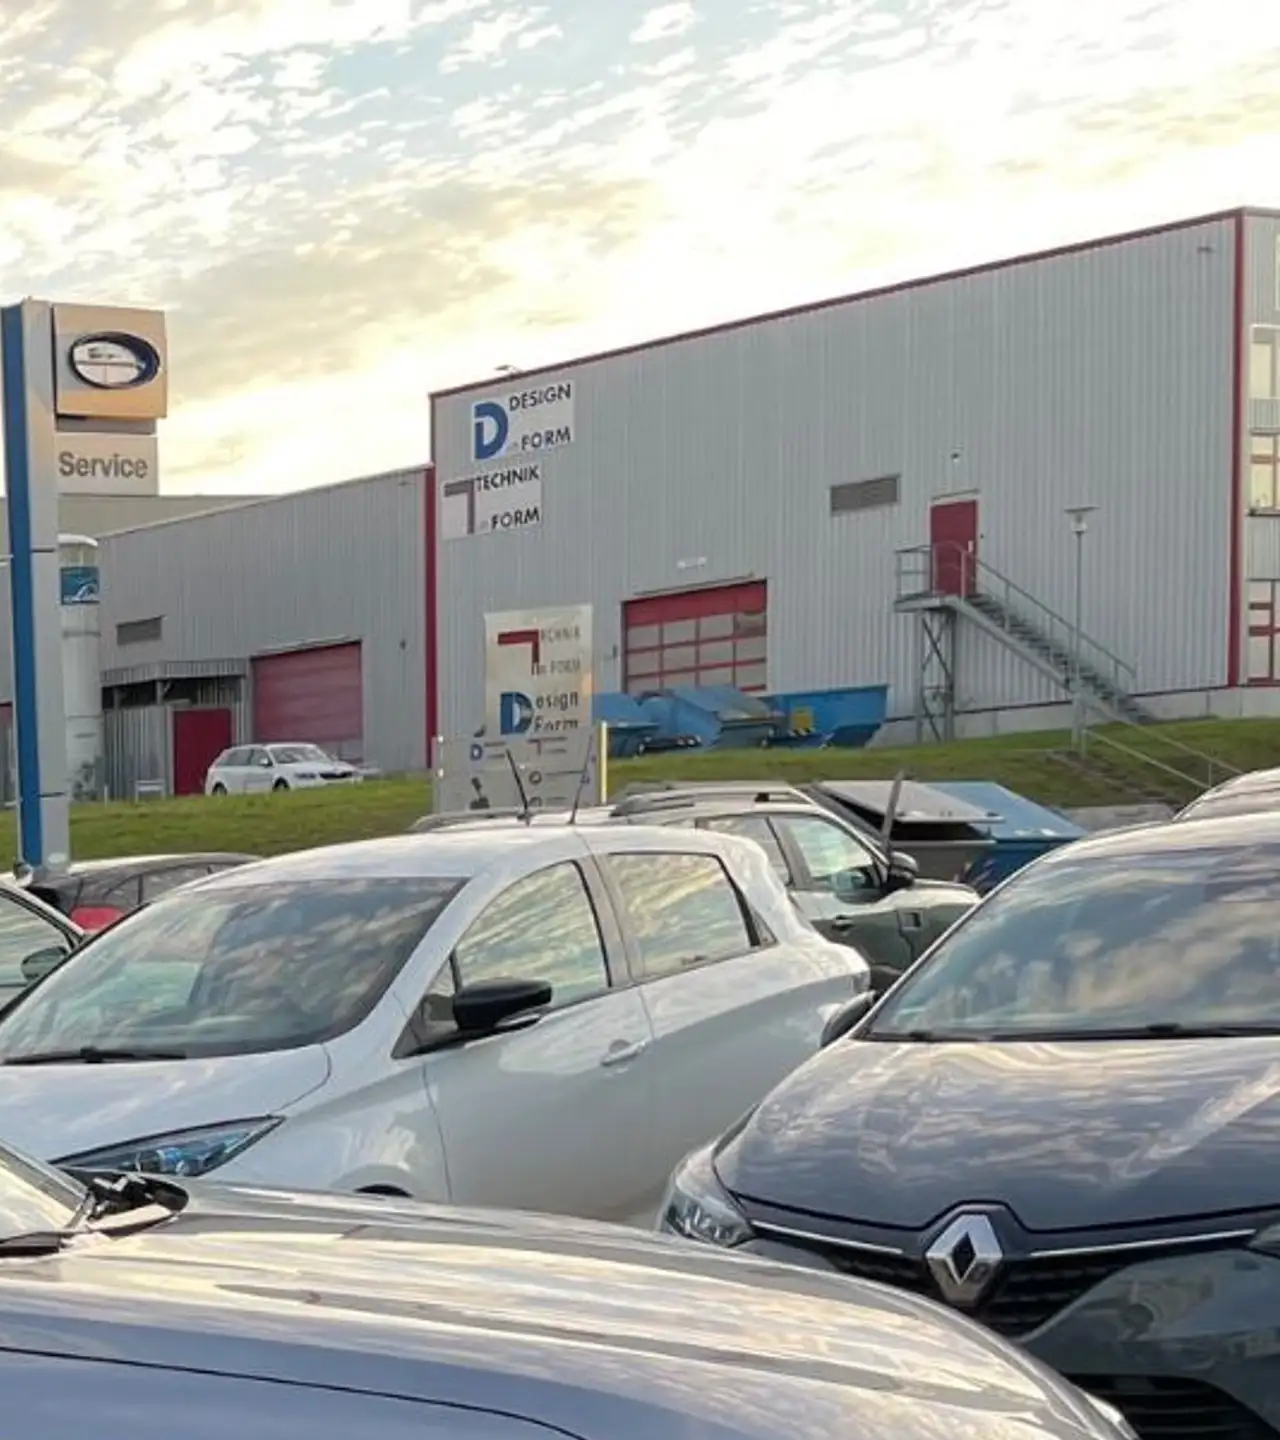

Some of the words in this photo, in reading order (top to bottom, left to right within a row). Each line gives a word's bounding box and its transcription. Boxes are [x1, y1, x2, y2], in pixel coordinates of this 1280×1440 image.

[509, 384, 571, 411] DESIGN
[521, 426, 571, 450] FORM
[58, 451, 148, 478] Service
[476, 466, 540, 491] TECHNIK
[491, 506, 540, 529] FORM
